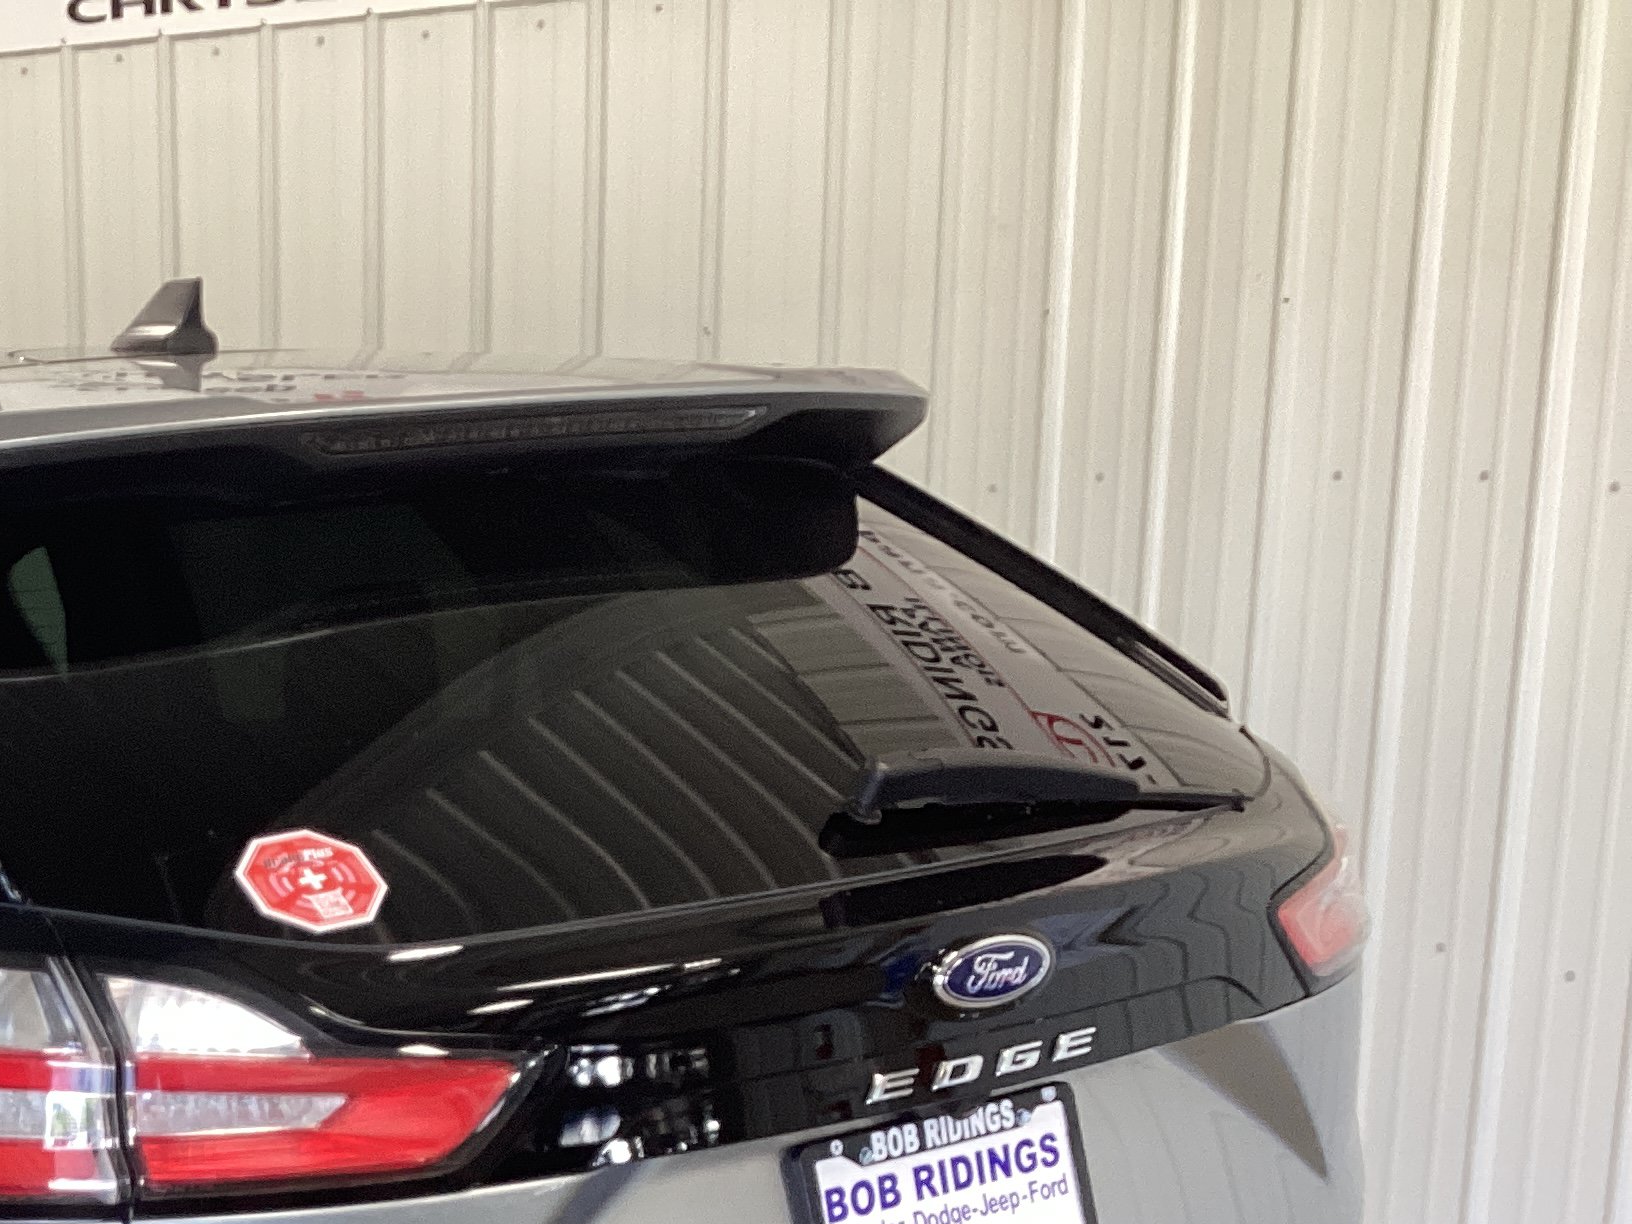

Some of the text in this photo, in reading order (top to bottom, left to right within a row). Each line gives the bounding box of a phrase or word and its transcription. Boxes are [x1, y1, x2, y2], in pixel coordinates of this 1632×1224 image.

[966, 951, 1030, 994] Ford
[865, 1026, 1097, 1106] EDGE
[870, 1098, 1017, 1162] BOB RIDINGS
[824, 1132, 1060, 1224] BOB RIDINGS
